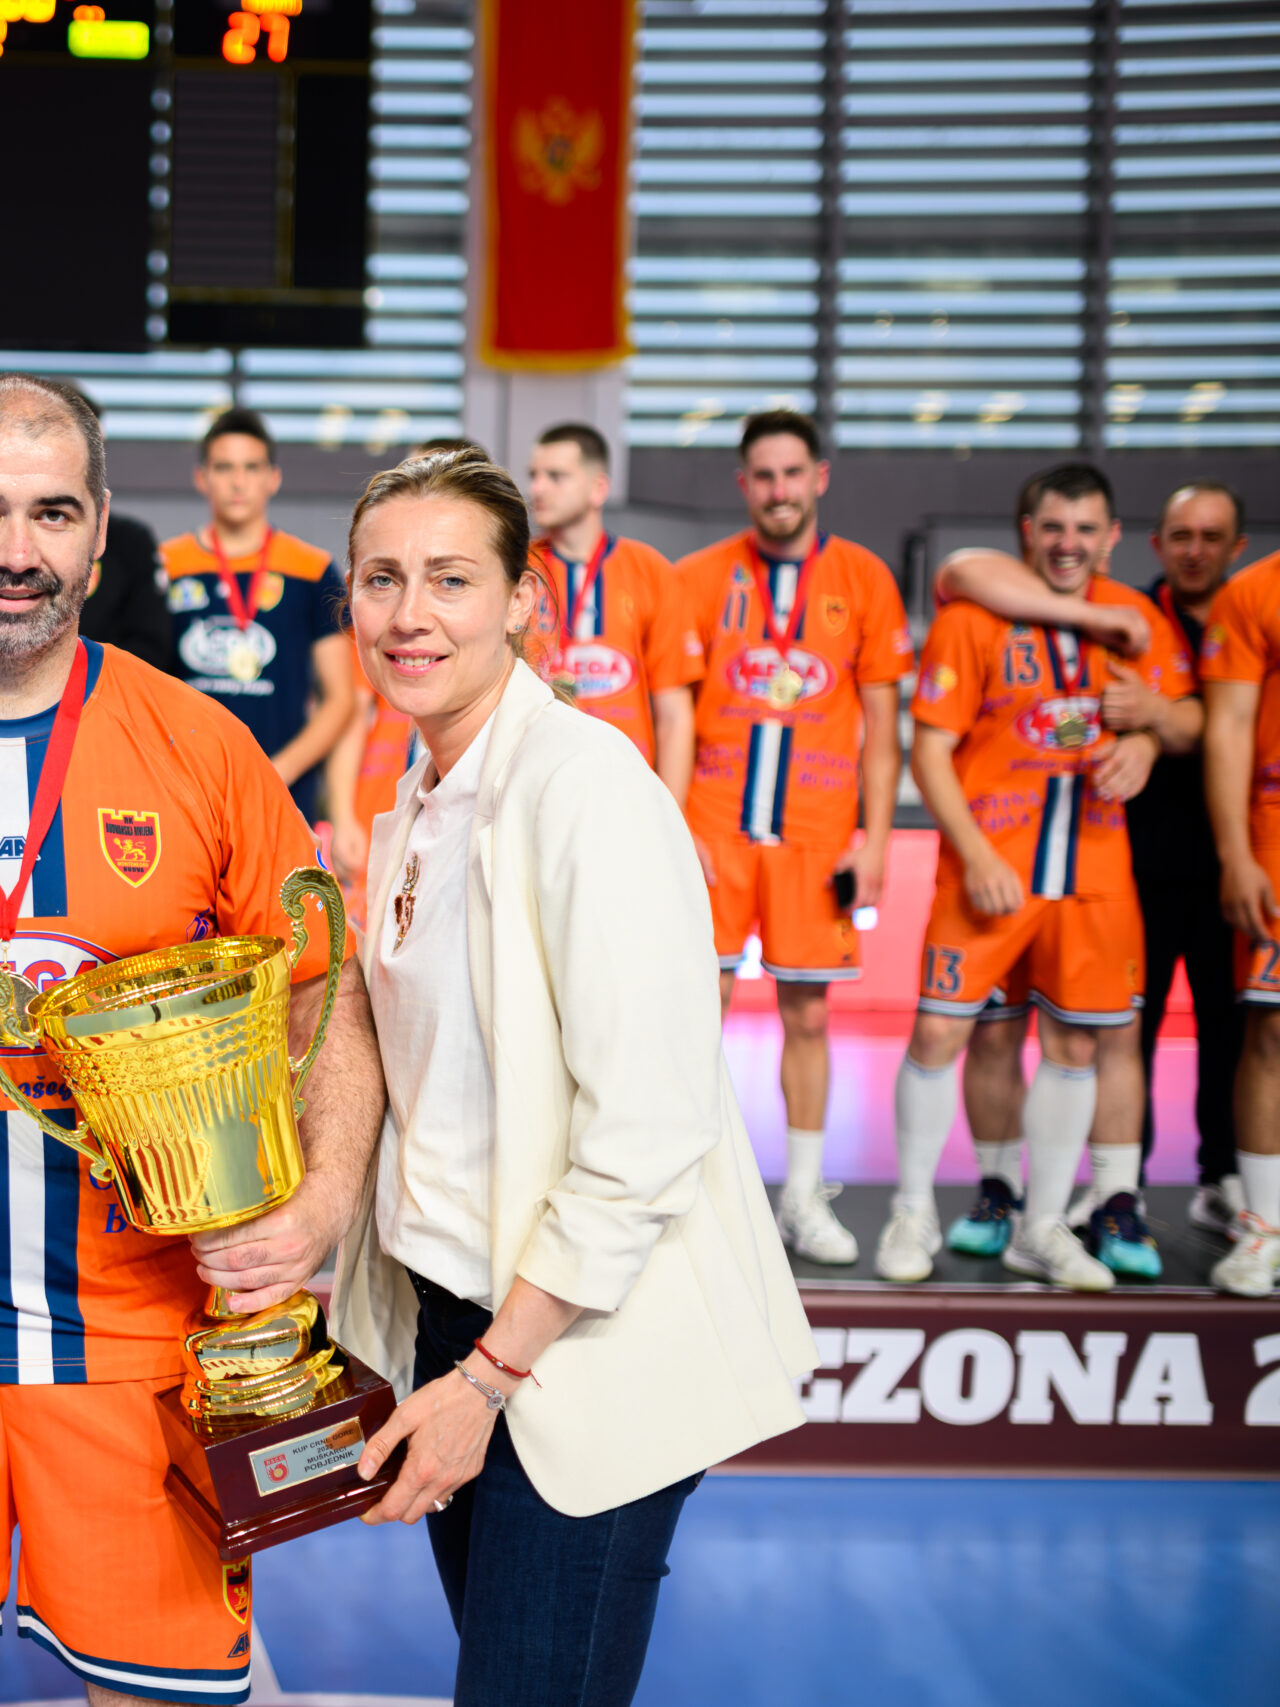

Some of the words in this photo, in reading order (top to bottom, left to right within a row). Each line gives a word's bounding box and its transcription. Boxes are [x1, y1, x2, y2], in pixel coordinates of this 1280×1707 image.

[1004, 642, 1040, 684] 13
[926, 948, 962, 994] 13
[292, 1444, 308, 1455] KUP
[304, 1450, 354, 1472] POBJEDNIK
